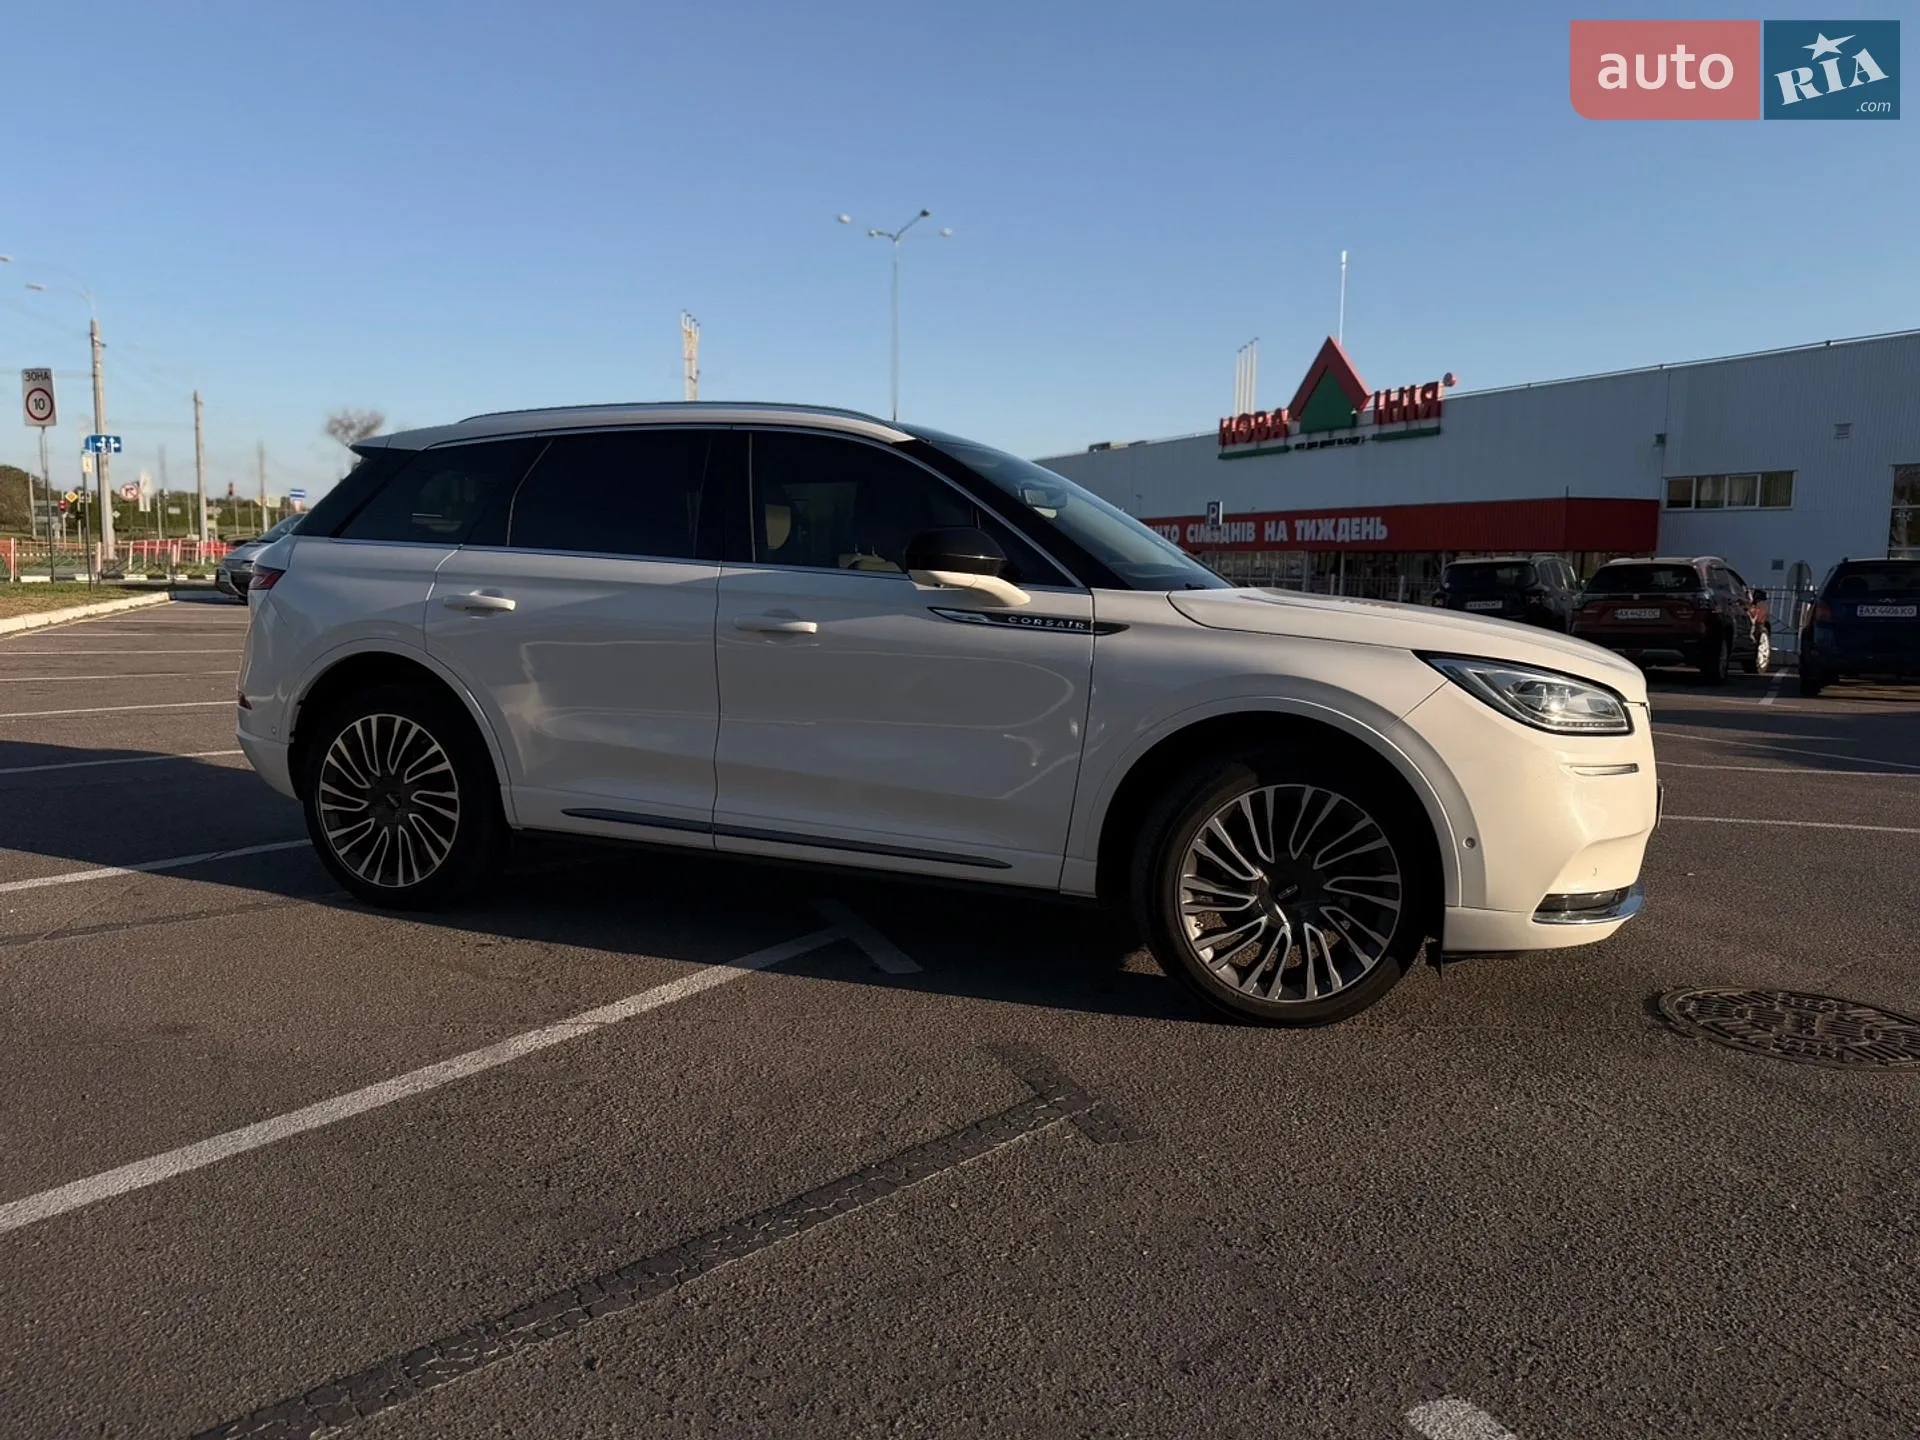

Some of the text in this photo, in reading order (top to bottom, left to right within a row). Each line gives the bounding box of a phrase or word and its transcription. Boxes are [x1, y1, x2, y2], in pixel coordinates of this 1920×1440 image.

[24, 371, 50, 381] ЗОНА
[34, 398, 46, 411] 10
[1219, 407, 1289, 446] НОВА
[1220, 521, 1256, 544] ДНІВ
[1264, 520, 1289, 543] НА
[1295, 517, 1388, 543] ТИЖДЕНЬ
[1008, 616, 1085, 630] CORSAIR
